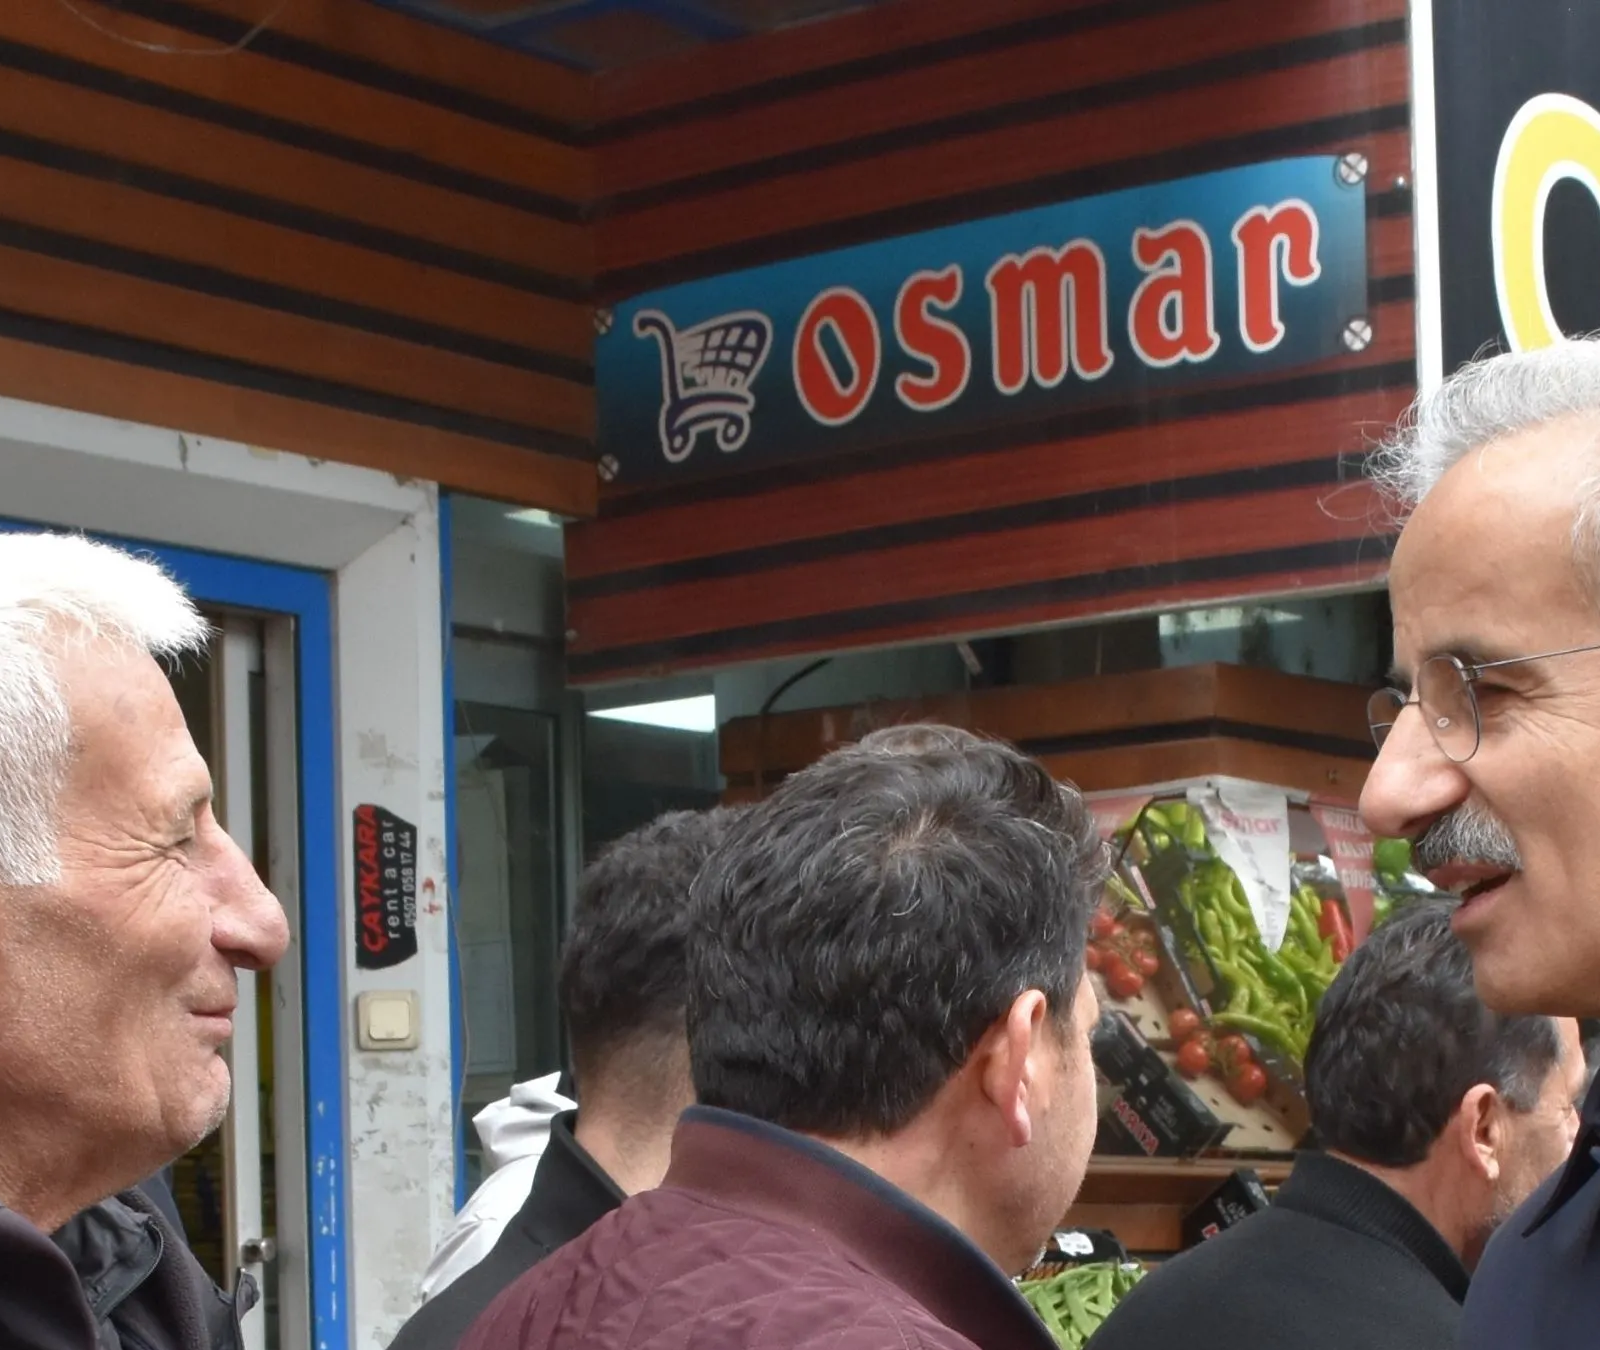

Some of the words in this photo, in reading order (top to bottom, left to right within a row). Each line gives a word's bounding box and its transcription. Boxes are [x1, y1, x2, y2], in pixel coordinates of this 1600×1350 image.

[793, 197, 1321, 426] osmar
[382, 820, 396, 858] car
[356, 804, 388, 953] ÇAYKARA
[385, 867, 397, 880] a
[384, 887, 401, 939] rent
